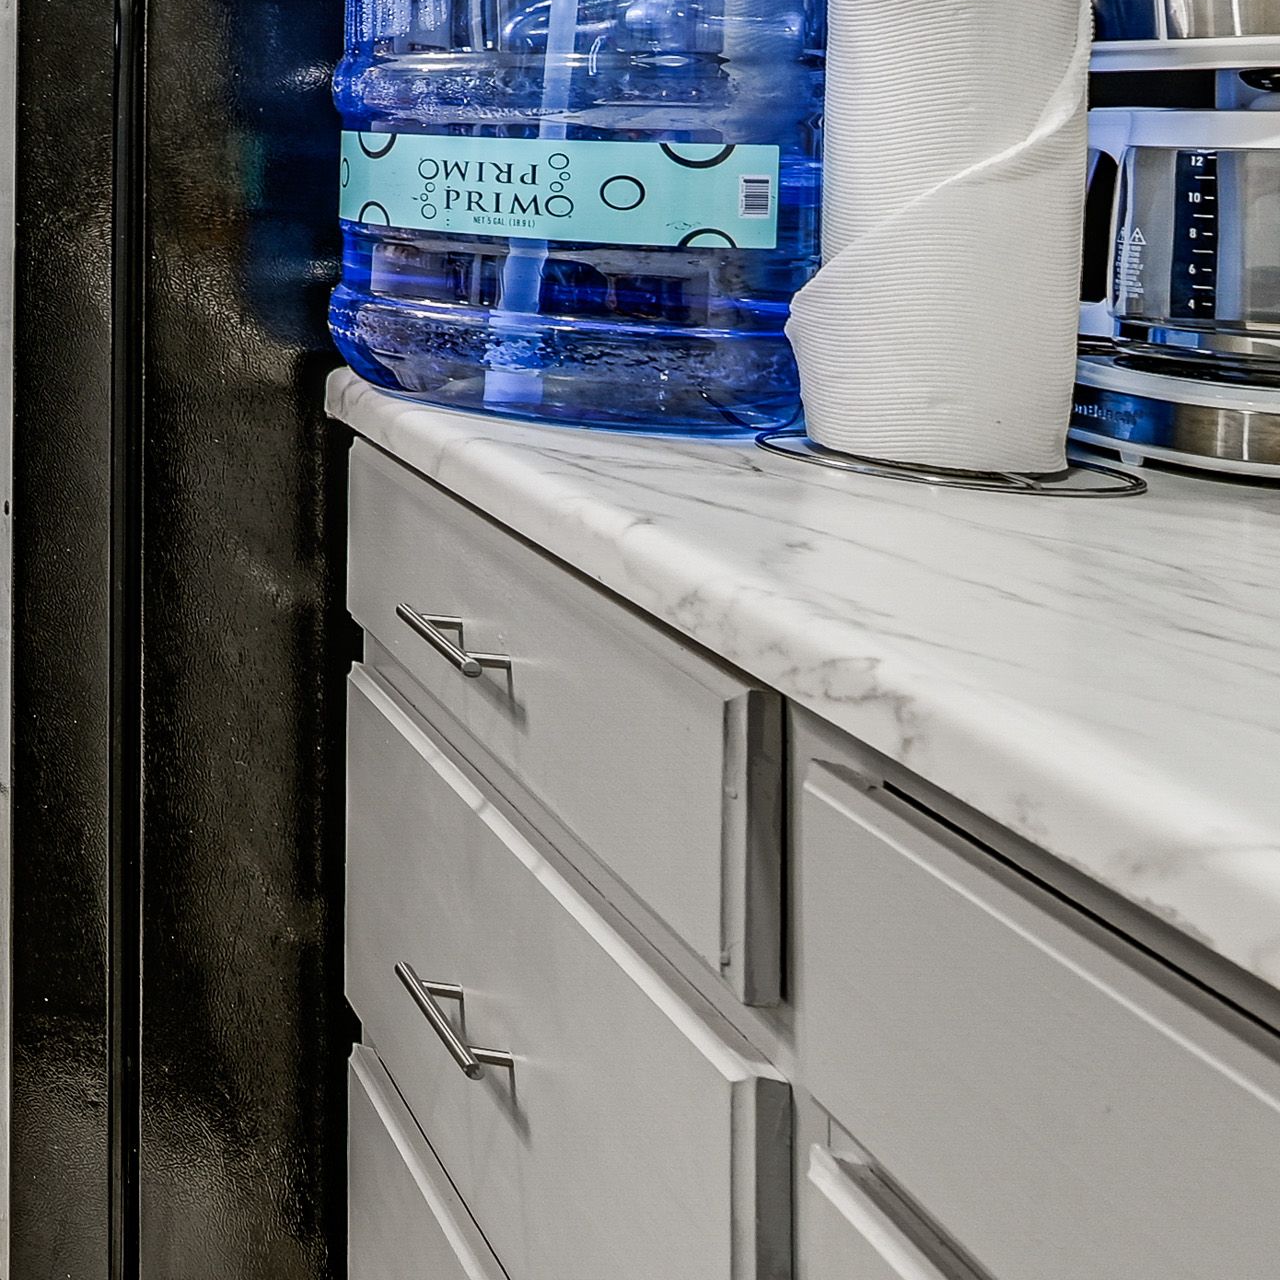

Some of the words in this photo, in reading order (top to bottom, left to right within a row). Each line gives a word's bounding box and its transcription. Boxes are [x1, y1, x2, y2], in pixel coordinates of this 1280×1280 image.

[1191, 156, 1203, 167] 12
[418, 158, 540, 185] PRIMO
[444, 188, 574, 218] PRIMO
[1188, 192, 1201, 203] 10
[473, 216, 485, 224] NET
[487, 216, 492, 225] 5
[1189, 228, 1197, 238] 8
[1188, 263, 1196, 274] 6
[1188, 299, 1195, 310] 4
